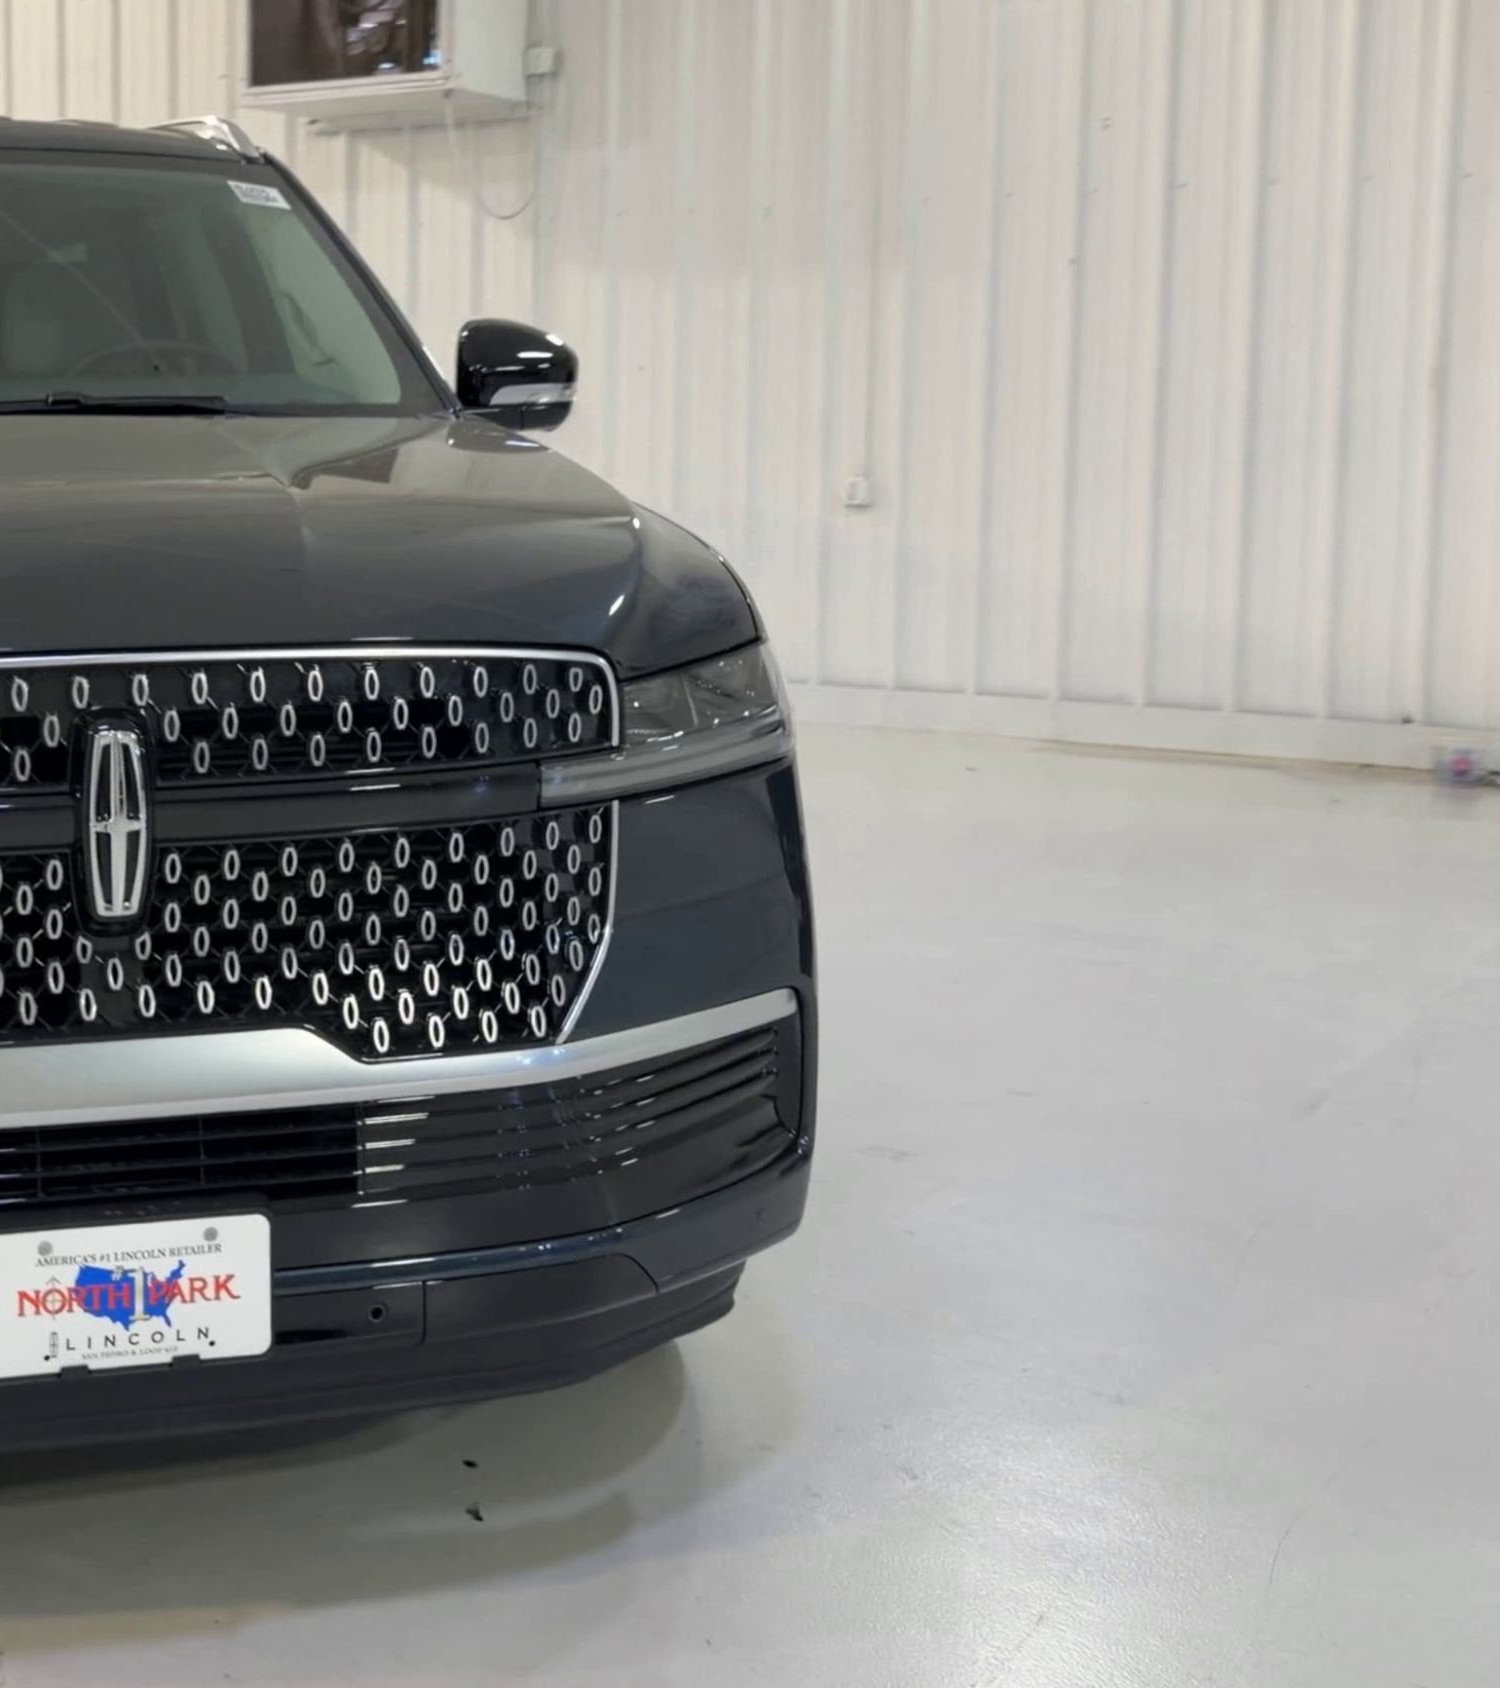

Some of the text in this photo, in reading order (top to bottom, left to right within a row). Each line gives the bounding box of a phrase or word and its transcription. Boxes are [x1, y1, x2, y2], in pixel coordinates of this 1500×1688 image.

[35, 1243, 222, 1268] AMERICA'S #1 LINCOLN RETAILER
[17, 1274, 241, 1317] NORTH PARK
[66, 1327, 210, 1351] LINCOLN
